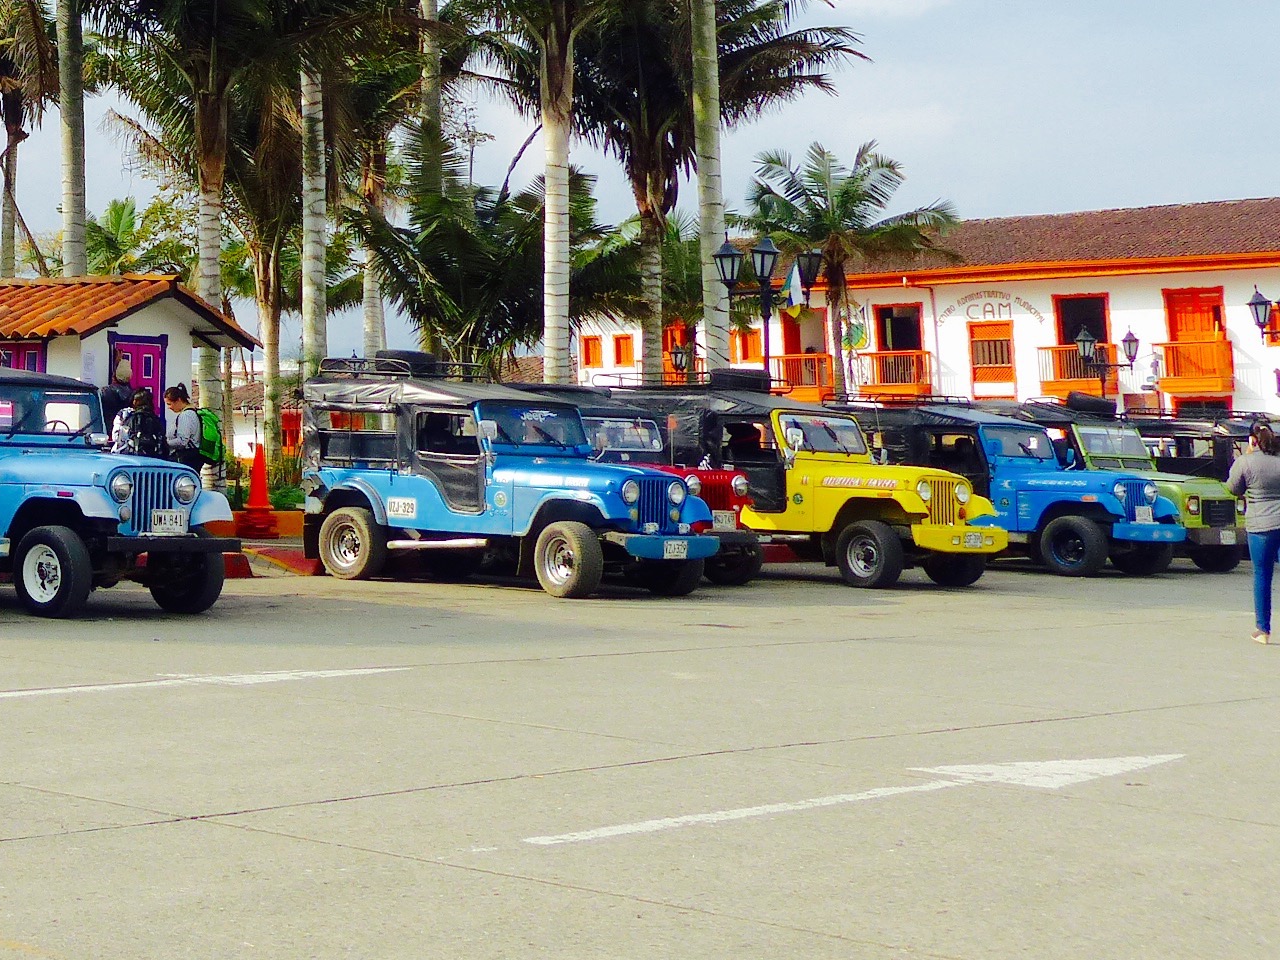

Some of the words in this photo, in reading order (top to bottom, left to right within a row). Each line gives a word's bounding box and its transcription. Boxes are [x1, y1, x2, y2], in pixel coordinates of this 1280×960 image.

[937, 305, 956, 327] CENTRO
[1014, 297, 1045, 325] MUNICIPAL
[966, 302, 1012, 320] CAM
[521, 410, 547, 423] Jeep
